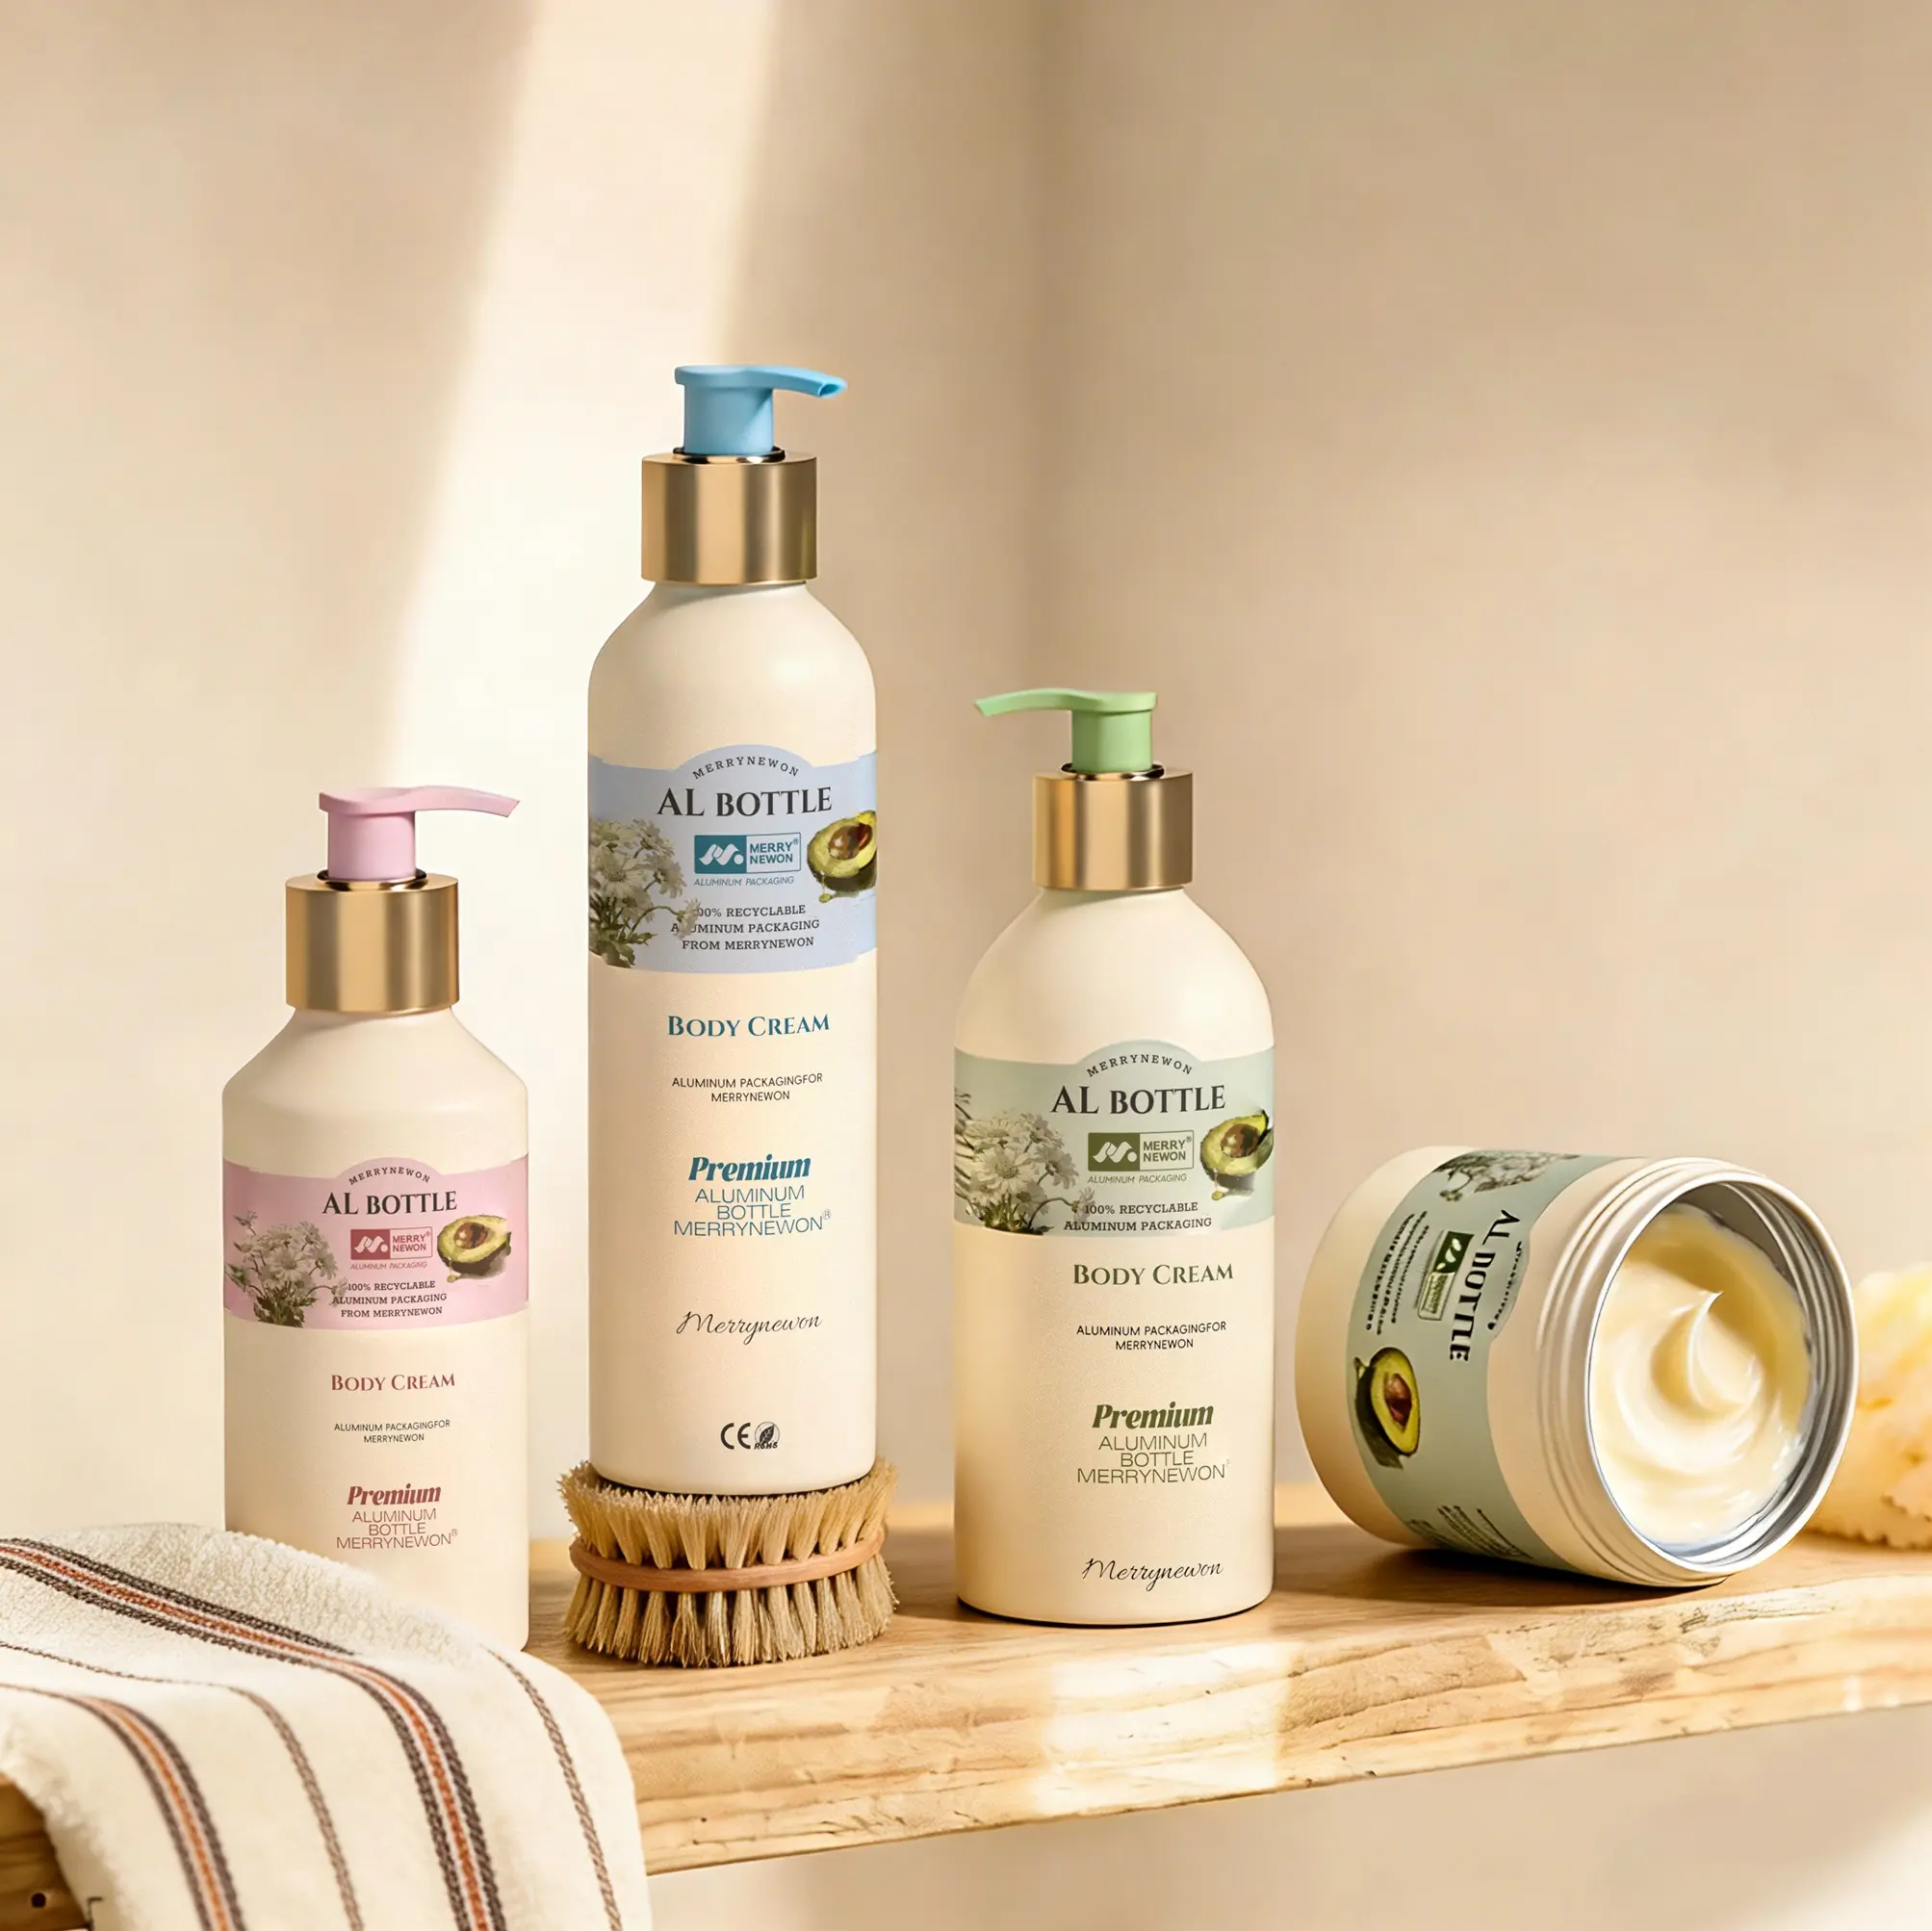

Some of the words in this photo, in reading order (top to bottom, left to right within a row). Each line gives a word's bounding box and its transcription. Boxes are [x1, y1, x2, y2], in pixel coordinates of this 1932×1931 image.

[692, 756, 799, 780] MERRYNEWON
[657, 787, 705, 816] AL
[716, 786, 833, 816] BOTTLE
[749, 854, 793, 865] NEWON
[694, 877, 742, 887] ALUMINUM
[746, 875, 794, 887] PACKAGING
[697, 907, 722, 917] 00%
[726, 904, 806, 917] RECYCLABLE
[671, 922, 744, 934] AUMINUM
[749, 919, 820, 934] PACKAGING
[682, 940, 720, 950] FROM
[724, 937, 814, 950] MERRYNEWON
[667, 1015, 741, 1037] BODY
[748, 1014, 831, 1037] CREAM
[1086, 1053, 1194, 1077] MERRYNEWON
[672, 1077, 736, 1089] ALUMINUM
[740, 1072, 823, 1089] PACKAGINGFOR
[710, 1091, 790, 1103] MERRYNEWON
[1050, 1085, 1098, 1115] AL
[1109, 1084, 1226, 1115] BOTTLE
[1144, 1150, 1186, 1162] NEWON
[688, 1154, 811, 1182] Premium
[348, 1167, 430, 1186] MERRYNEWON
[1087, 1174, 1135, 1184] ALUMINUM
[1139, 1172, 1187, 1184] PACKAGING
[695, 1185, 805, 1203] ALUMINUM
[322, 1192, 359, 1215] AL
[366, 1191, 457, 1216] BOTTLE
[1085, 1204, 1116, 1215] 100%
[1120, 1201, 1198, 1215] RECYCLABLE
[717, 1203, 791, 1221] BOTTLE
[1064, 1221, 1137, 1231] ALUMINUM
[1141, 1217, 1212, 1232] PACKAGING
[393, 1243, 426, 1252] NEWON
[350, 1262, 387, 1271] ALUMINUM
[389, 1261, 427, 1271] PACKAGING
[1073, 1264, 1146, 1285] BODY
[1152, 1263, 1234, 1285] CREAM
[348, 1282, 371, 1292] 100%
[374, 1280, 436, 1292] RECYCLABLE
[332, 1296, 388, 1305] ALUMINUM
[391, 1293, 448, 1305] PACKAGING
[341, 1309, 370, 1318] FROM
[373, 1306, 443, 1319] MERRYNEWON
[676, 1311, 823, 1346] Merrynewon
[1076, 1325, 1140, 1336] ALUMINUM
[1145, 1321, 1226, 1336] PACKAGINGFOR
[1115, 1338, 1194, 1351] MERRYNEWON
[331, 1375, 386, 1391] BODY
[391, 1373, 455, 1391] CREAM
[1092, 1401, 1215, 1429] Premium
[334, 1423, 383, 1432] ALUMINUM
[385, 1420, 451, 1432] PACKAGINGFOR
[364, 1433, 425, 1444] MERRYNEWON
[1098, 1432, 1207, 1451] ALUMINUM
[1121, 1451, 1194, 1468] BOTTLE
[347, 1483, 442, 1506] Premium
[352, 1507, 436, 1523] ALUMINUM
[369, 1522, 426, 1536] BOTTLE
[1082, 1558, 1224, 1592] Merrynewon
